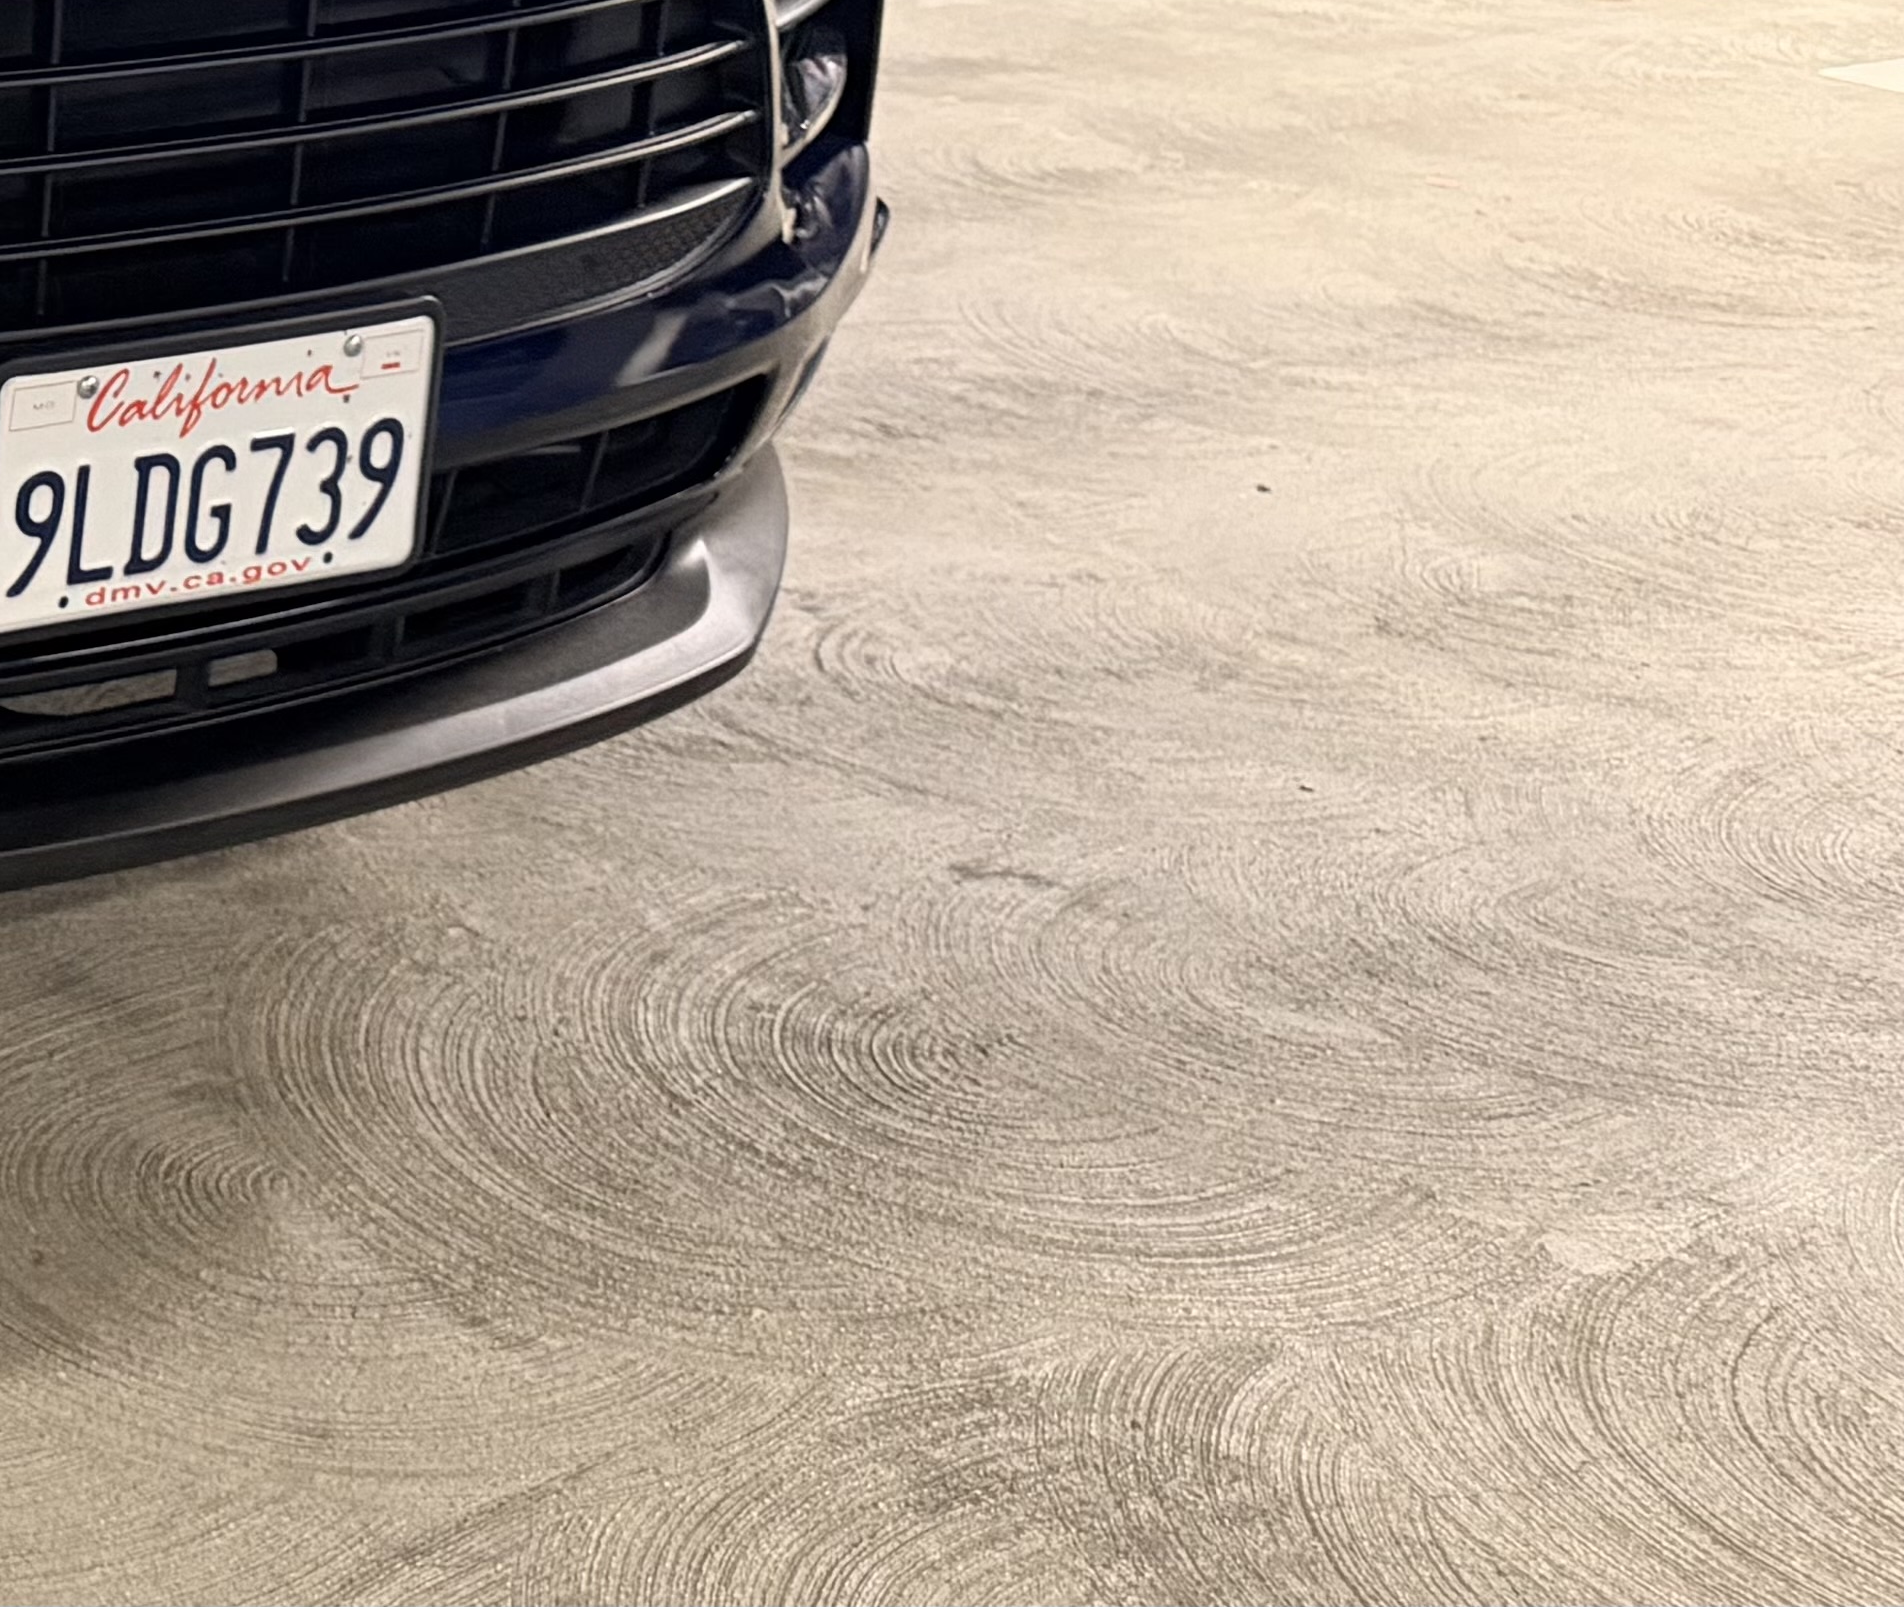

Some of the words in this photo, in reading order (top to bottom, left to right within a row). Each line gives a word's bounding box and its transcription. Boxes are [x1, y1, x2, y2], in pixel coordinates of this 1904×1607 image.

[85, 357, 360, 439] California
[5, 417, 406, 599] 9LDG739
[84, 555, 313, 607] dmv.ca.gov
